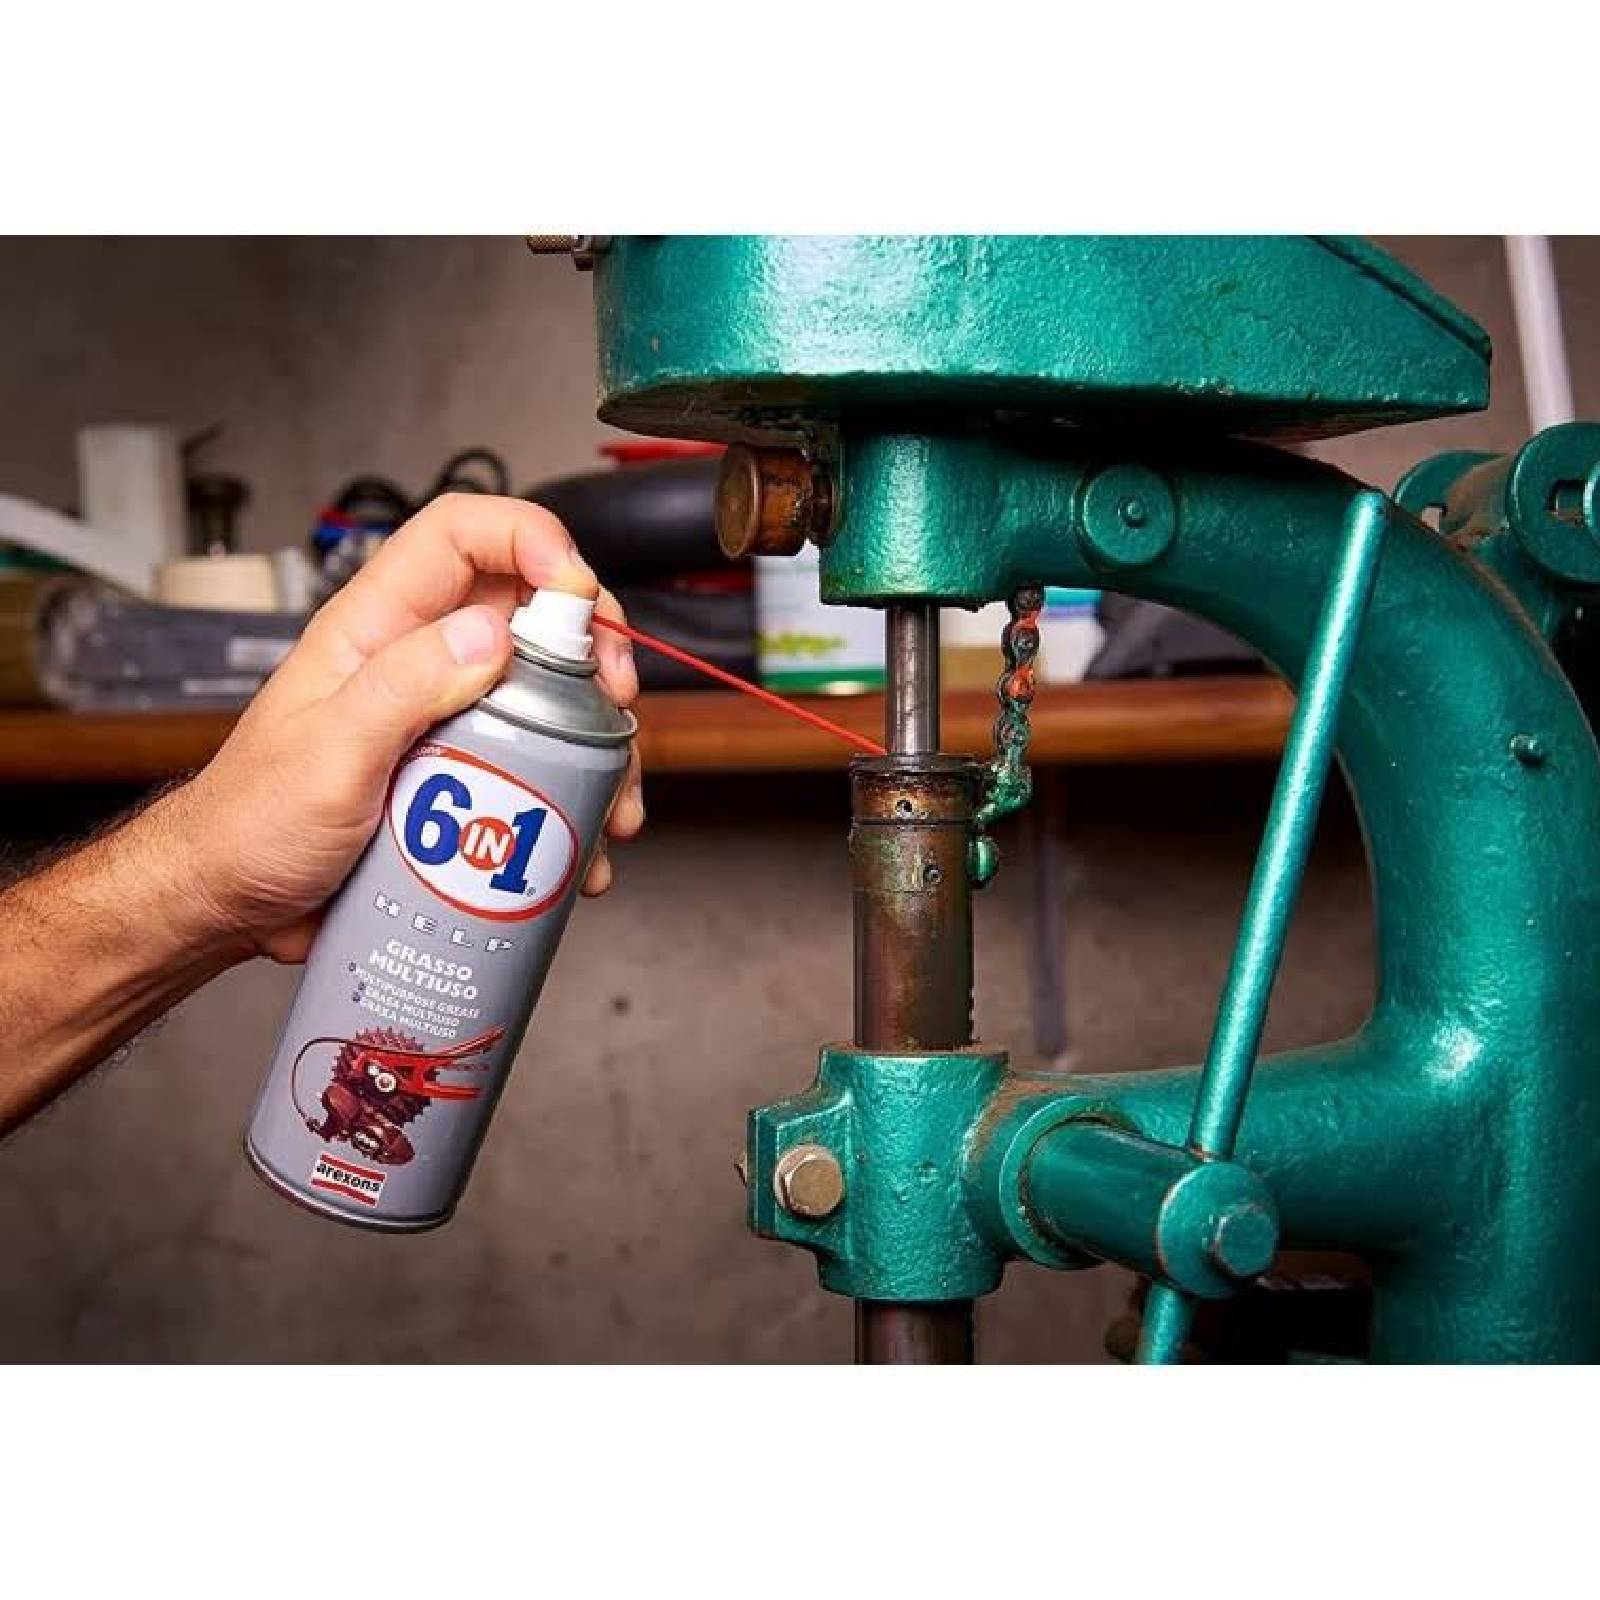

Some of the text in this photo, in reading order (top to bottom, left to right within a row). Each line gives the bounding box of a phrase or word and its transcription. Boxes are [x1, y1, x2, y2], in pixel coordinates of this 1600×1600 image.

[375, 890, 515, 953] HELP
[368, 950, 478, 1000] MULTIUSO
[386, 939, 473, 981] GRASSO
[316, 1163, 380, 1192] arexons
